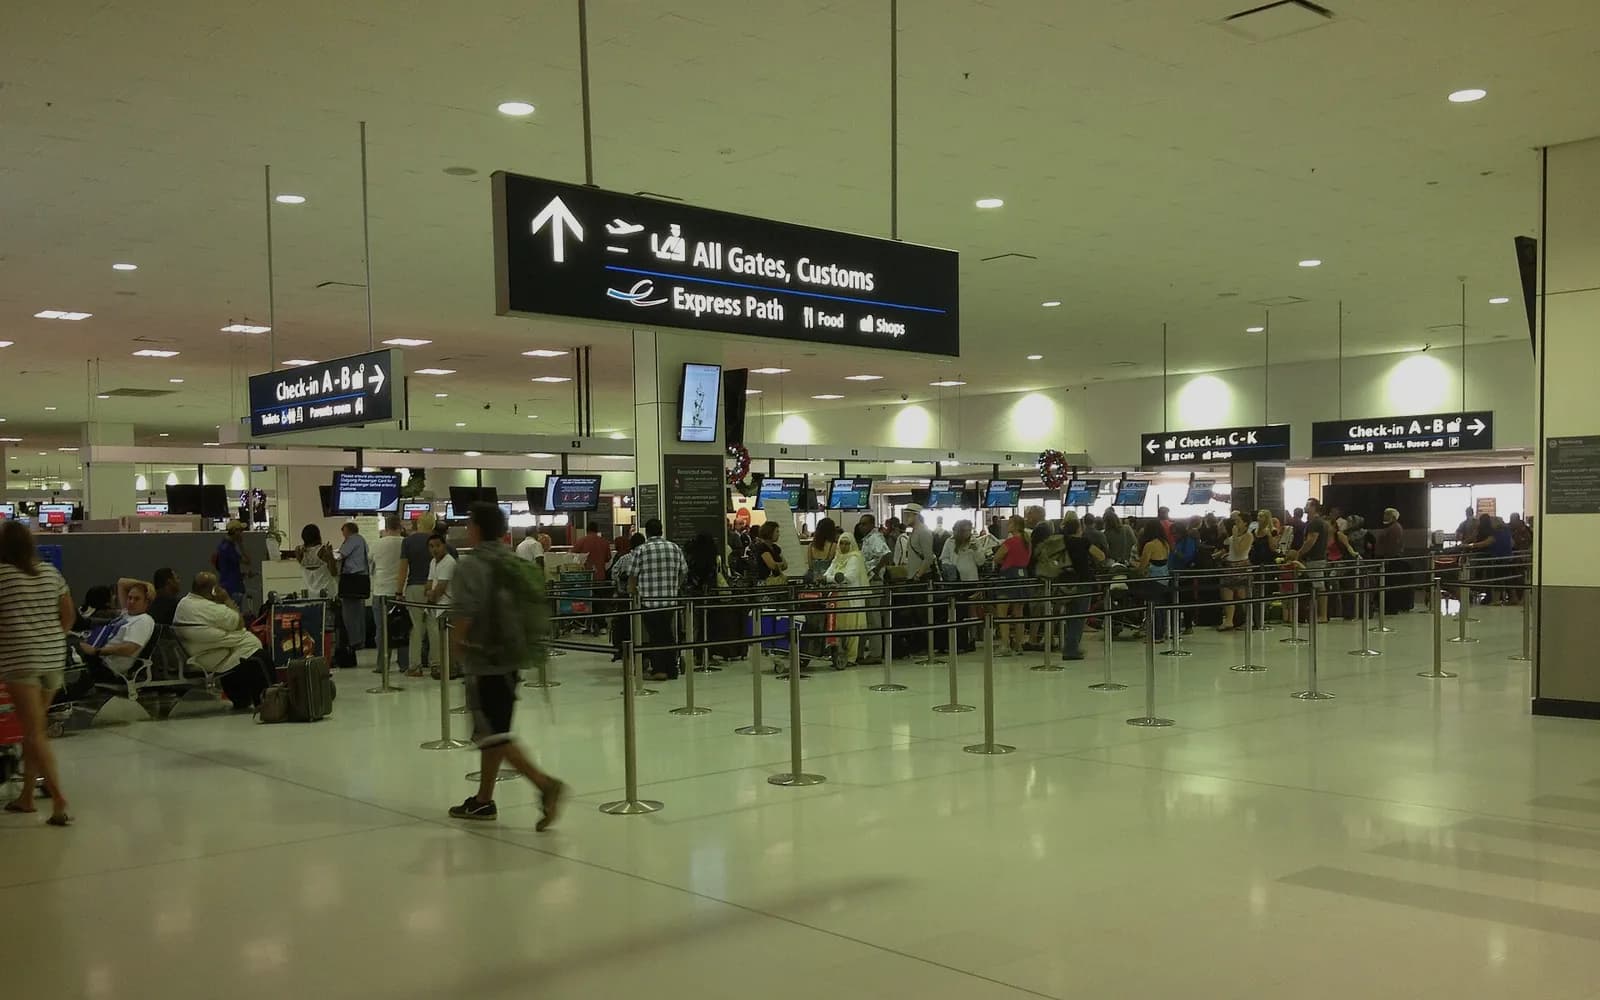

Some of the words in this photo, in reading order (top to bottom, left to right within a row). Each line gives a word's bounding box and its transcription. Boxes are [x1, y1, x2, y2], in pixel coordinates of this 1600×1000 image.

[693, 241, 722, 270] All
[728, 247, 791, 283] Gates,
[797, 257, 875, 292] Customs
[673, 287, 742, 318] Express
[746, 295, 784, 321] Path
[818, 311, 844, 329] Food
[876, 317, 906, 339] Shops
[276, 374, 319, 401] Check-in
[1179, 435, 1226, 448] Check-in
[1349, 423, 1404, 438] Check-in
